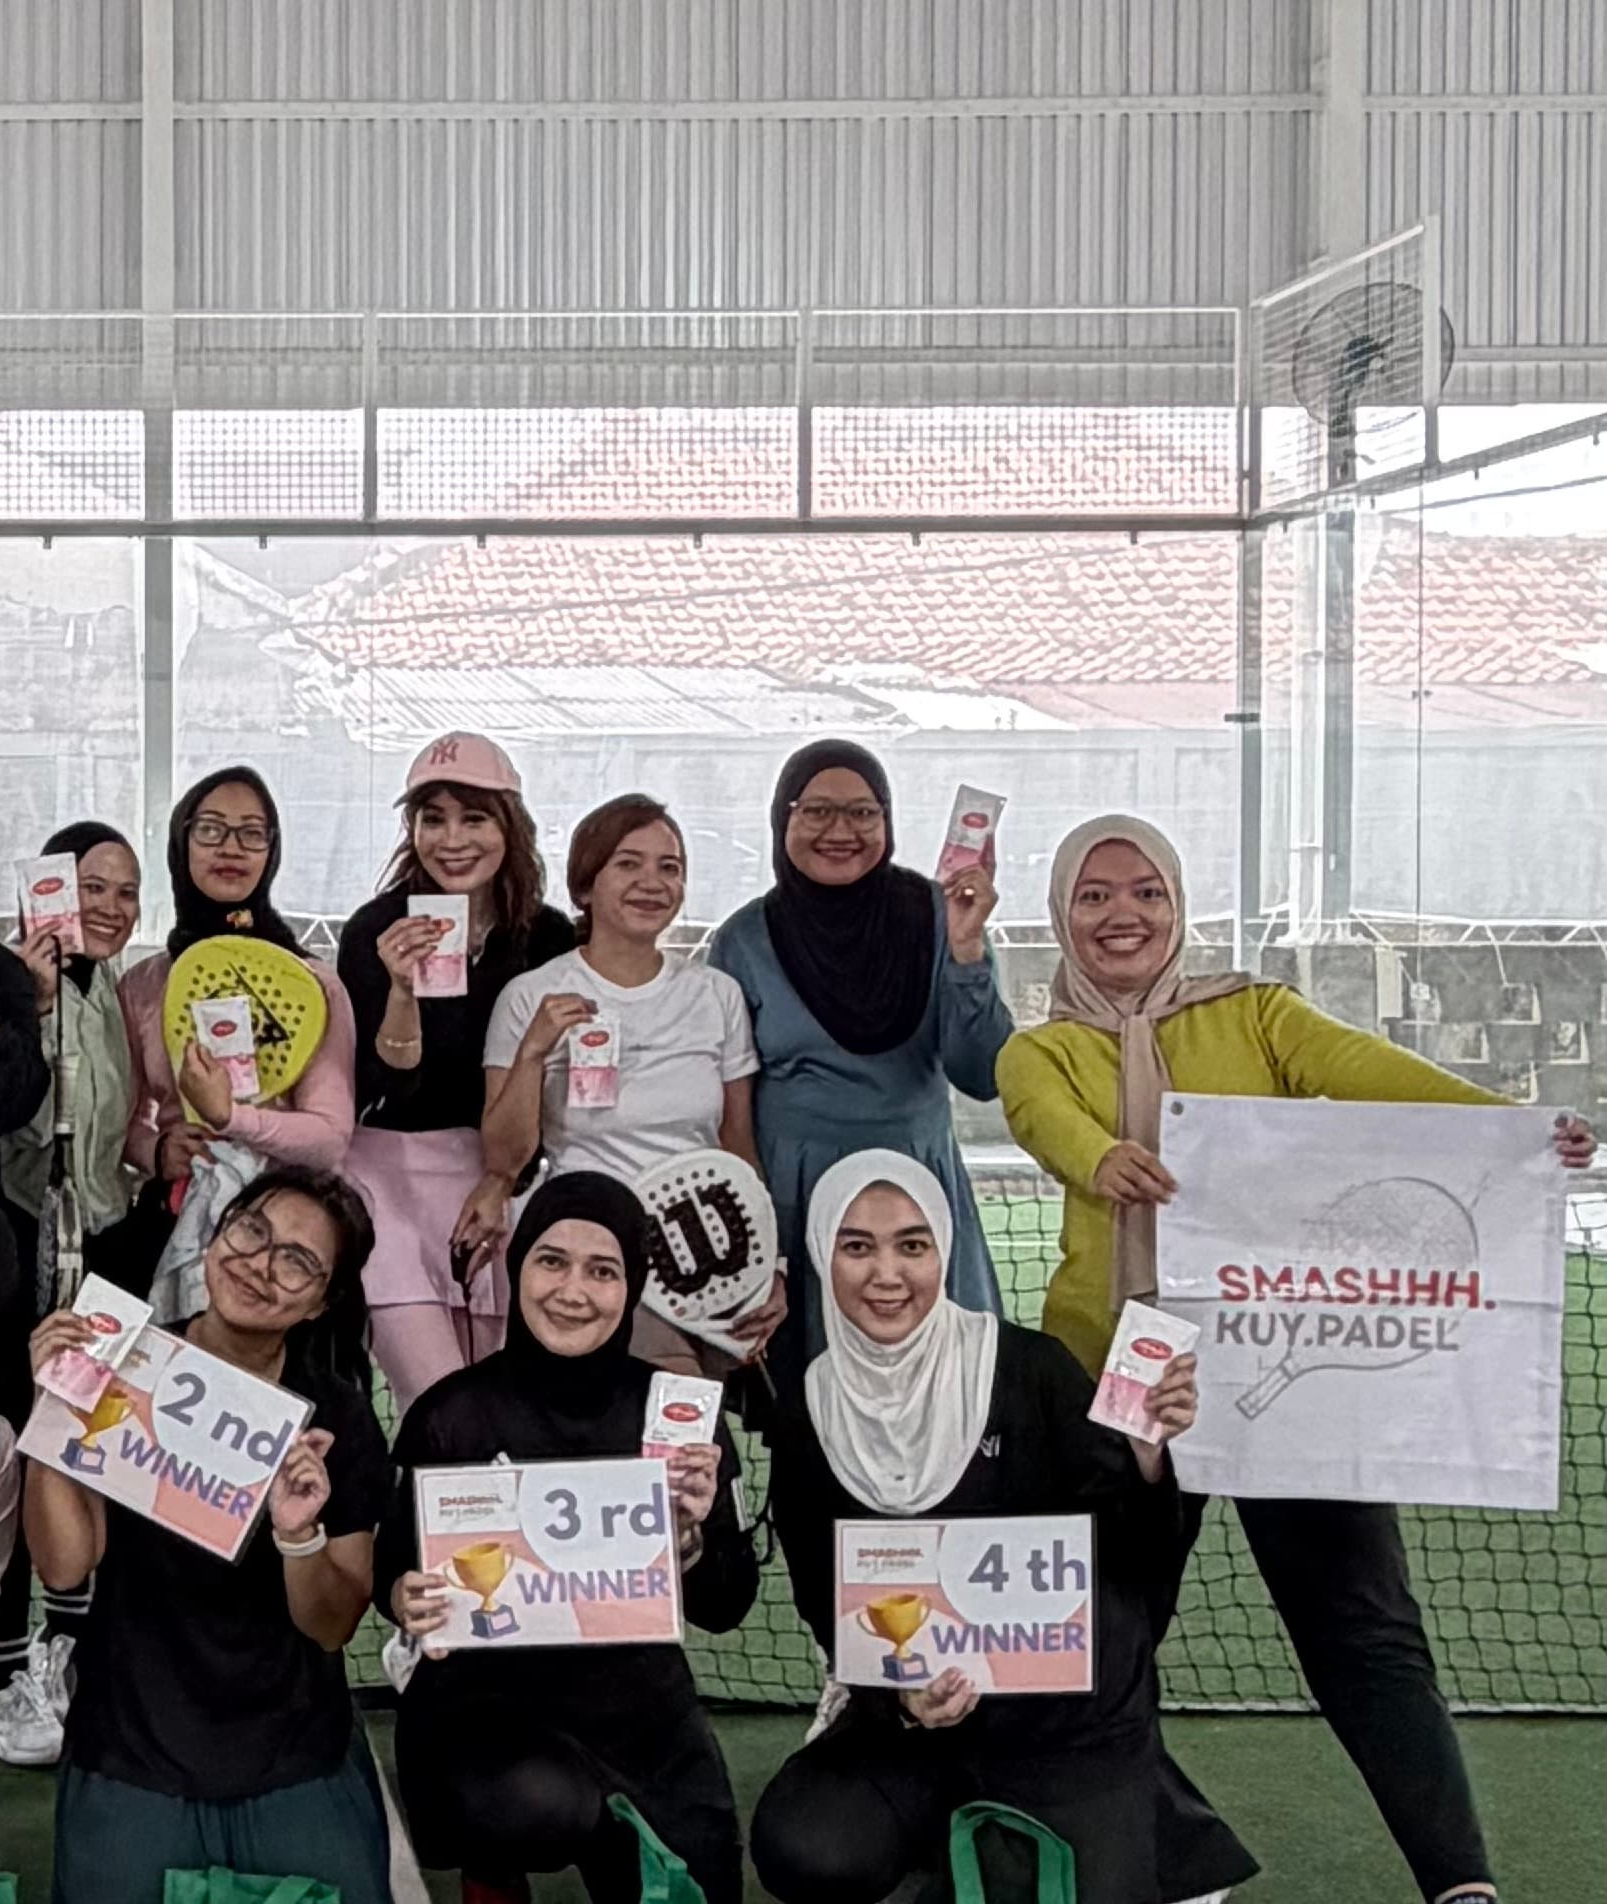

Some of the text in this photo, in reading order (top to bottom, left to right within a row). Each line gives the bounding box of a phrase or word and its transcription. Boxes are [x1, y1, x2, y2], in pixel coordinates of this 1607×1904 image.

[1217, 1264, 1496, 1310] SMASHHH.
[1216, 1311, 1459, 1352] KUY.PADEL
[120, 1429, 255, 1521] WINNER
[516, 1568, 671, 1604] WINNER
[931, 1622, 1086, 1654] WINNER
